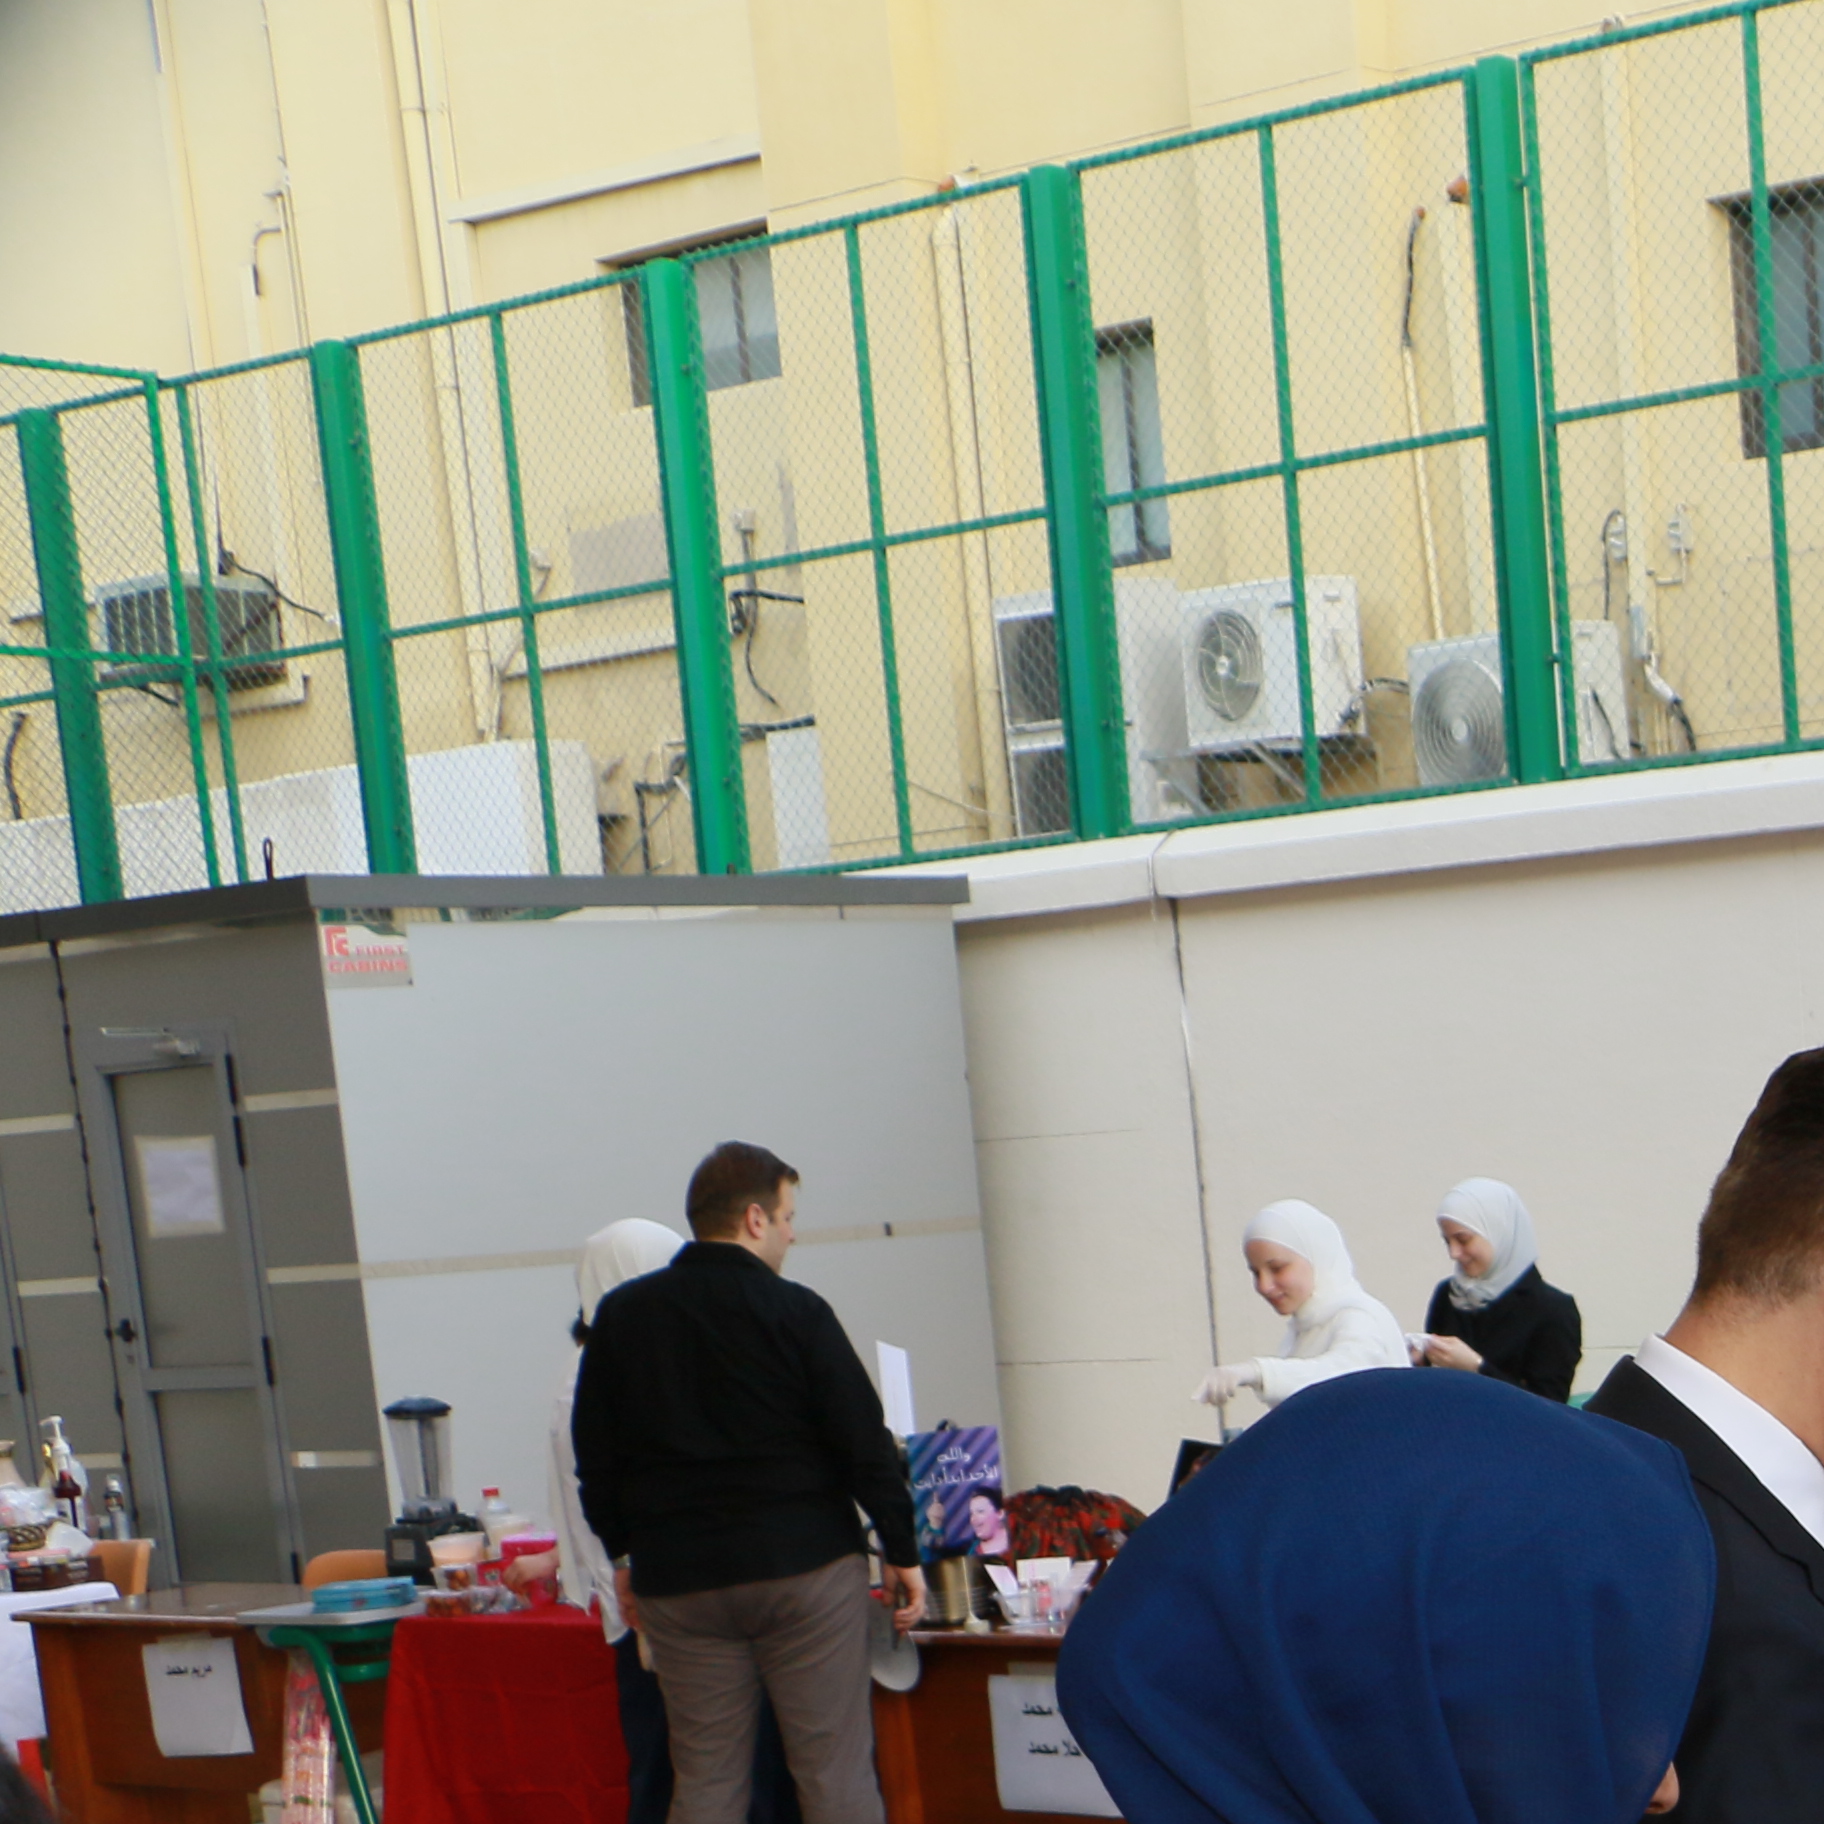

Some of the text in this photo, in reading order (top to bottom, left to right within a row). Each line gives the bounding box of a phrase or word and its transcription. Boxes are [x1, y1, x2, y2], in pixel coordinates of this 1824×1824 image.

[355, 945, 404, 956] FIRST
[328, 958, 409, 974] CABINS
[165, 1664, 188, 1676] محمد
[1028, 1741, 1059, 1755] محمد
